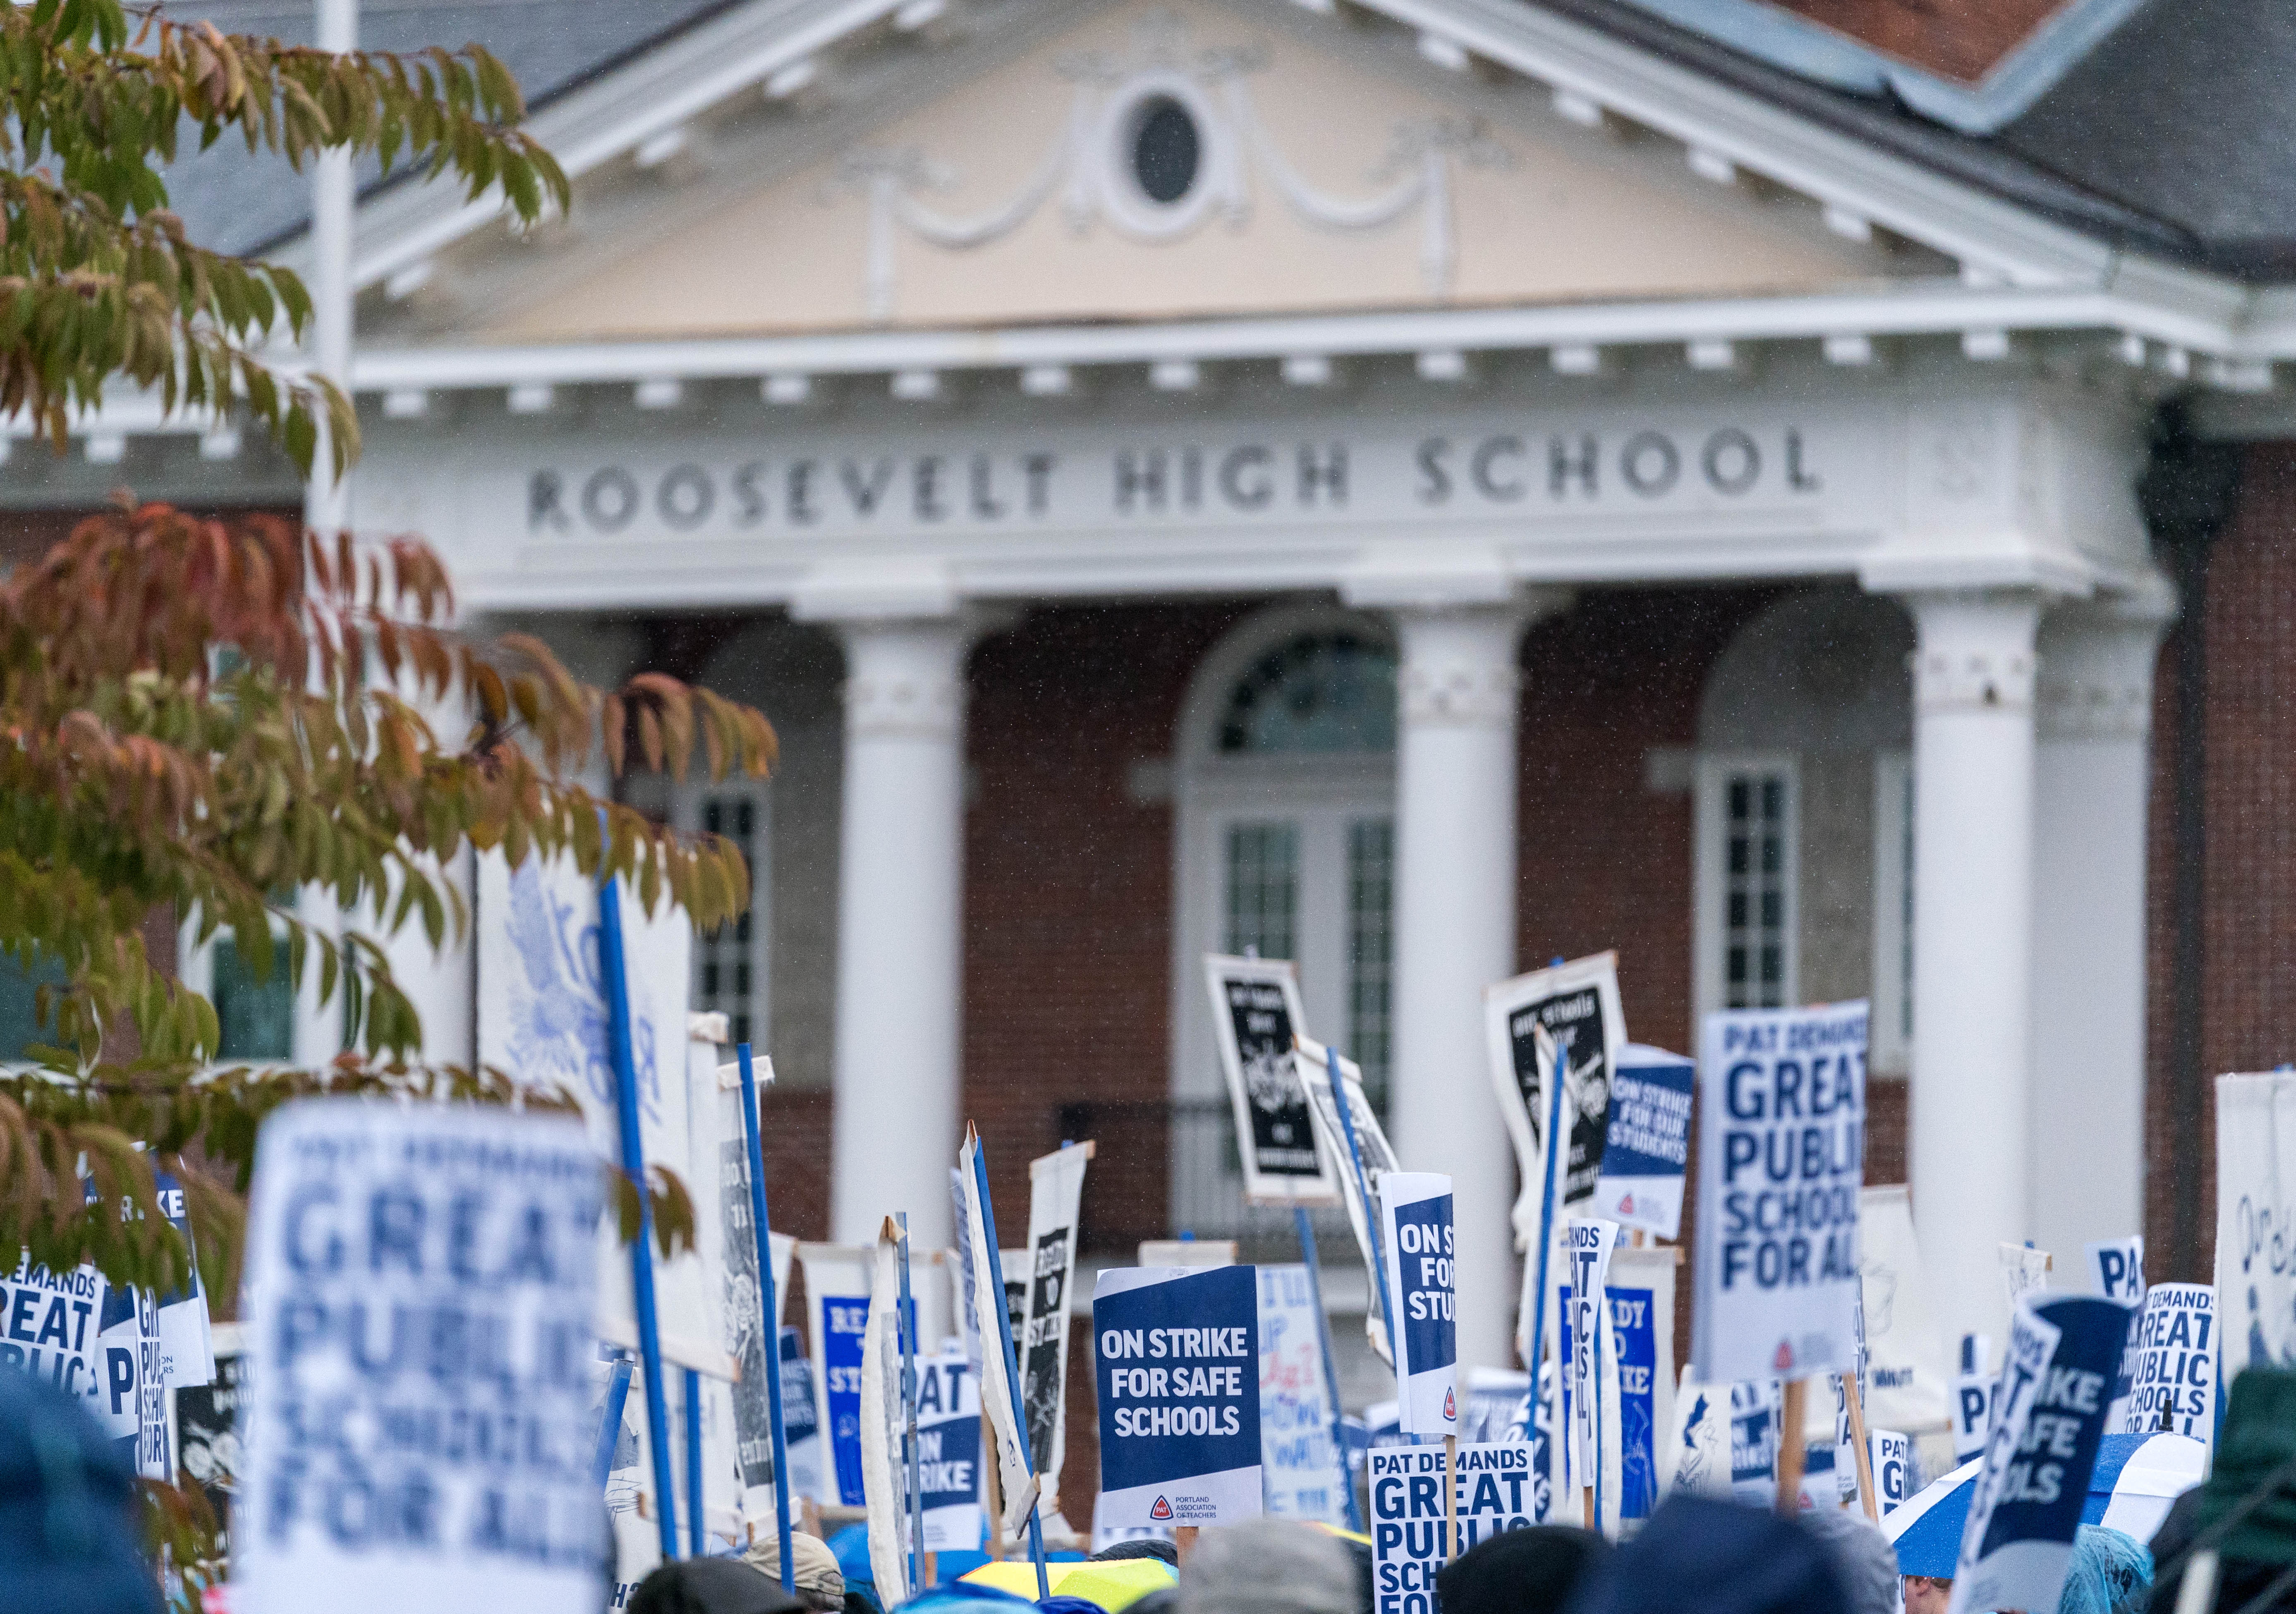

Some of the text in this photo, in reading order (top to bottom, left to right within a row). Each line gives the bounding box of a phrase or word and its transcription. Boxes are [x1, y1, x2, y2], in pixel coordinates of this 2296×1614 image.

[527, 426, 1823, 534] ROOSEVELT HIGH SCHOOL
[1722, 1122, 1856, 1183] PUBLI
[1401, 1224, 1454, 1255] ON S
[0, 1262, 96, 1299] EMANDS
[1721, 1237, 1811, 1291] FOR
[2099, 1248, 2139, 1298] PA
[1101, 1329, 1144, 1359] ON
[1149, 1327, 1248, 1358] STRIKE
[2138, 1311, 2212, 1351] REAT
[1111, 1367, 1170, 1398] FOR
[1172, 1367, 1242, 1397] SAFE
[2136, 1350, 2210, 1388] UBLIC
[2128, 1386, 2206, 1416] CHOOLS
[1114, 1406, 1240, 1437] SCHOOLS
[1373, 1449, 1527, 1475] PAT DEMANDS
[1375, 1471, 1529, 1520] GREAT
[1379, 1559, 1444, 1593] SCH
[1380, 1591, 1444, 1614] FO
